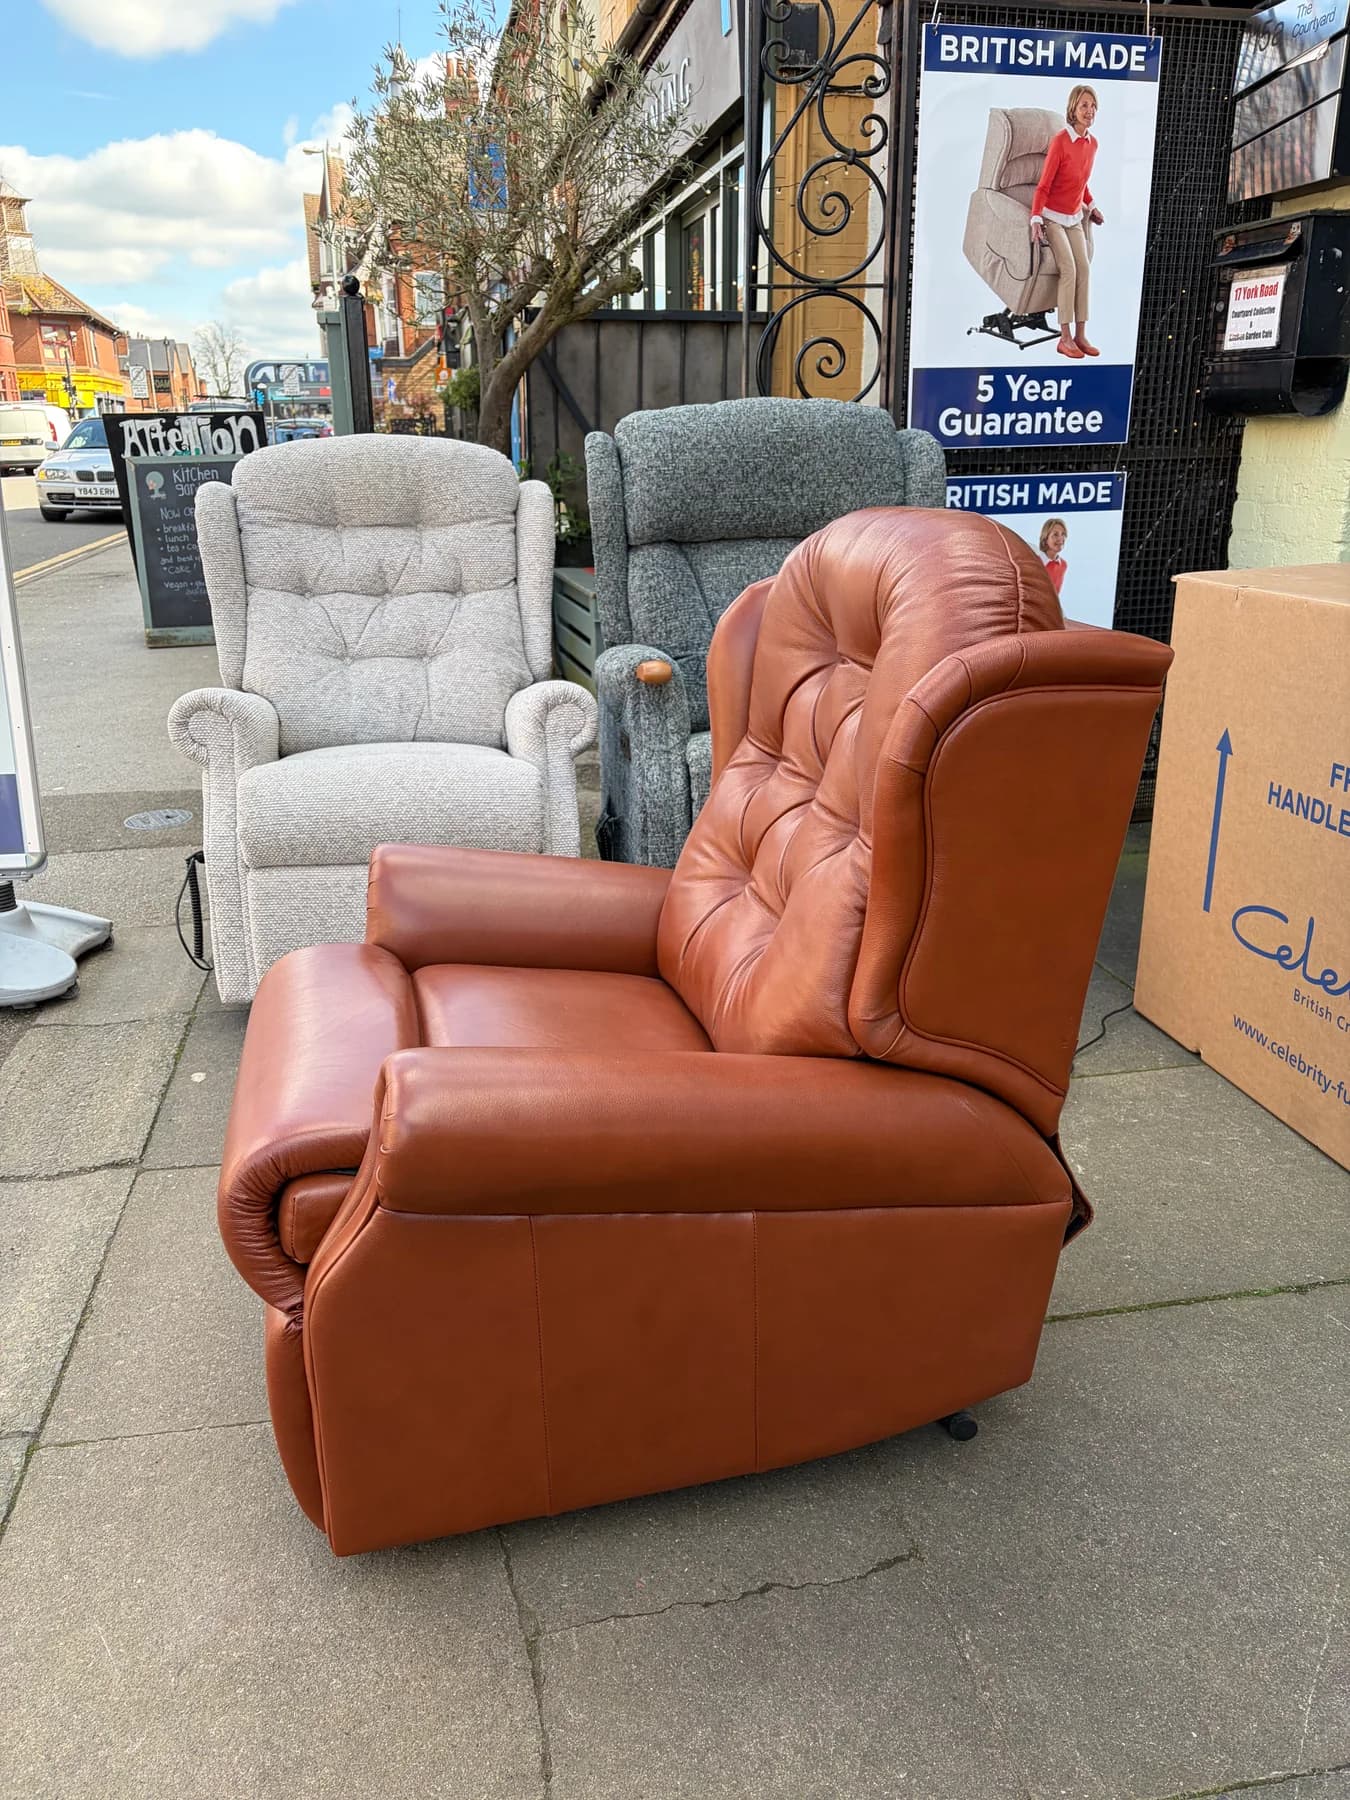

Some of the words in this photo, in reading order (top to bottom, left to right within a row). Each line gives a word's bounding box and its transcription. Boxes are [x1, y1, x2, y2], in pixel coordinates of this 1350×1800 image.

[1292, 7, 1336, 38] Courtyard
[1297, 3, 1313, 19] The
[940, 34, 1055, 67] BRITISH
[1064, 42, 1147, 72] MADE
[1234, 287, 1242, 301] 17
[1243, 284, 1259, 300] York
[1260, 281, 1279, 298] Road
[976, 374, 995, 403] 5
[1005, 374, 1073, 402] Year
[938, 406, 1103, 437] Guarantee
[175, 483, 199, 496] gar
[946, 483, 1030, 508] RITISH
[1038, 481, 1113, 505] MADE
[1267, 780, 1350, 837] HANDLE
[1293, 988, 1332, 1023] British
